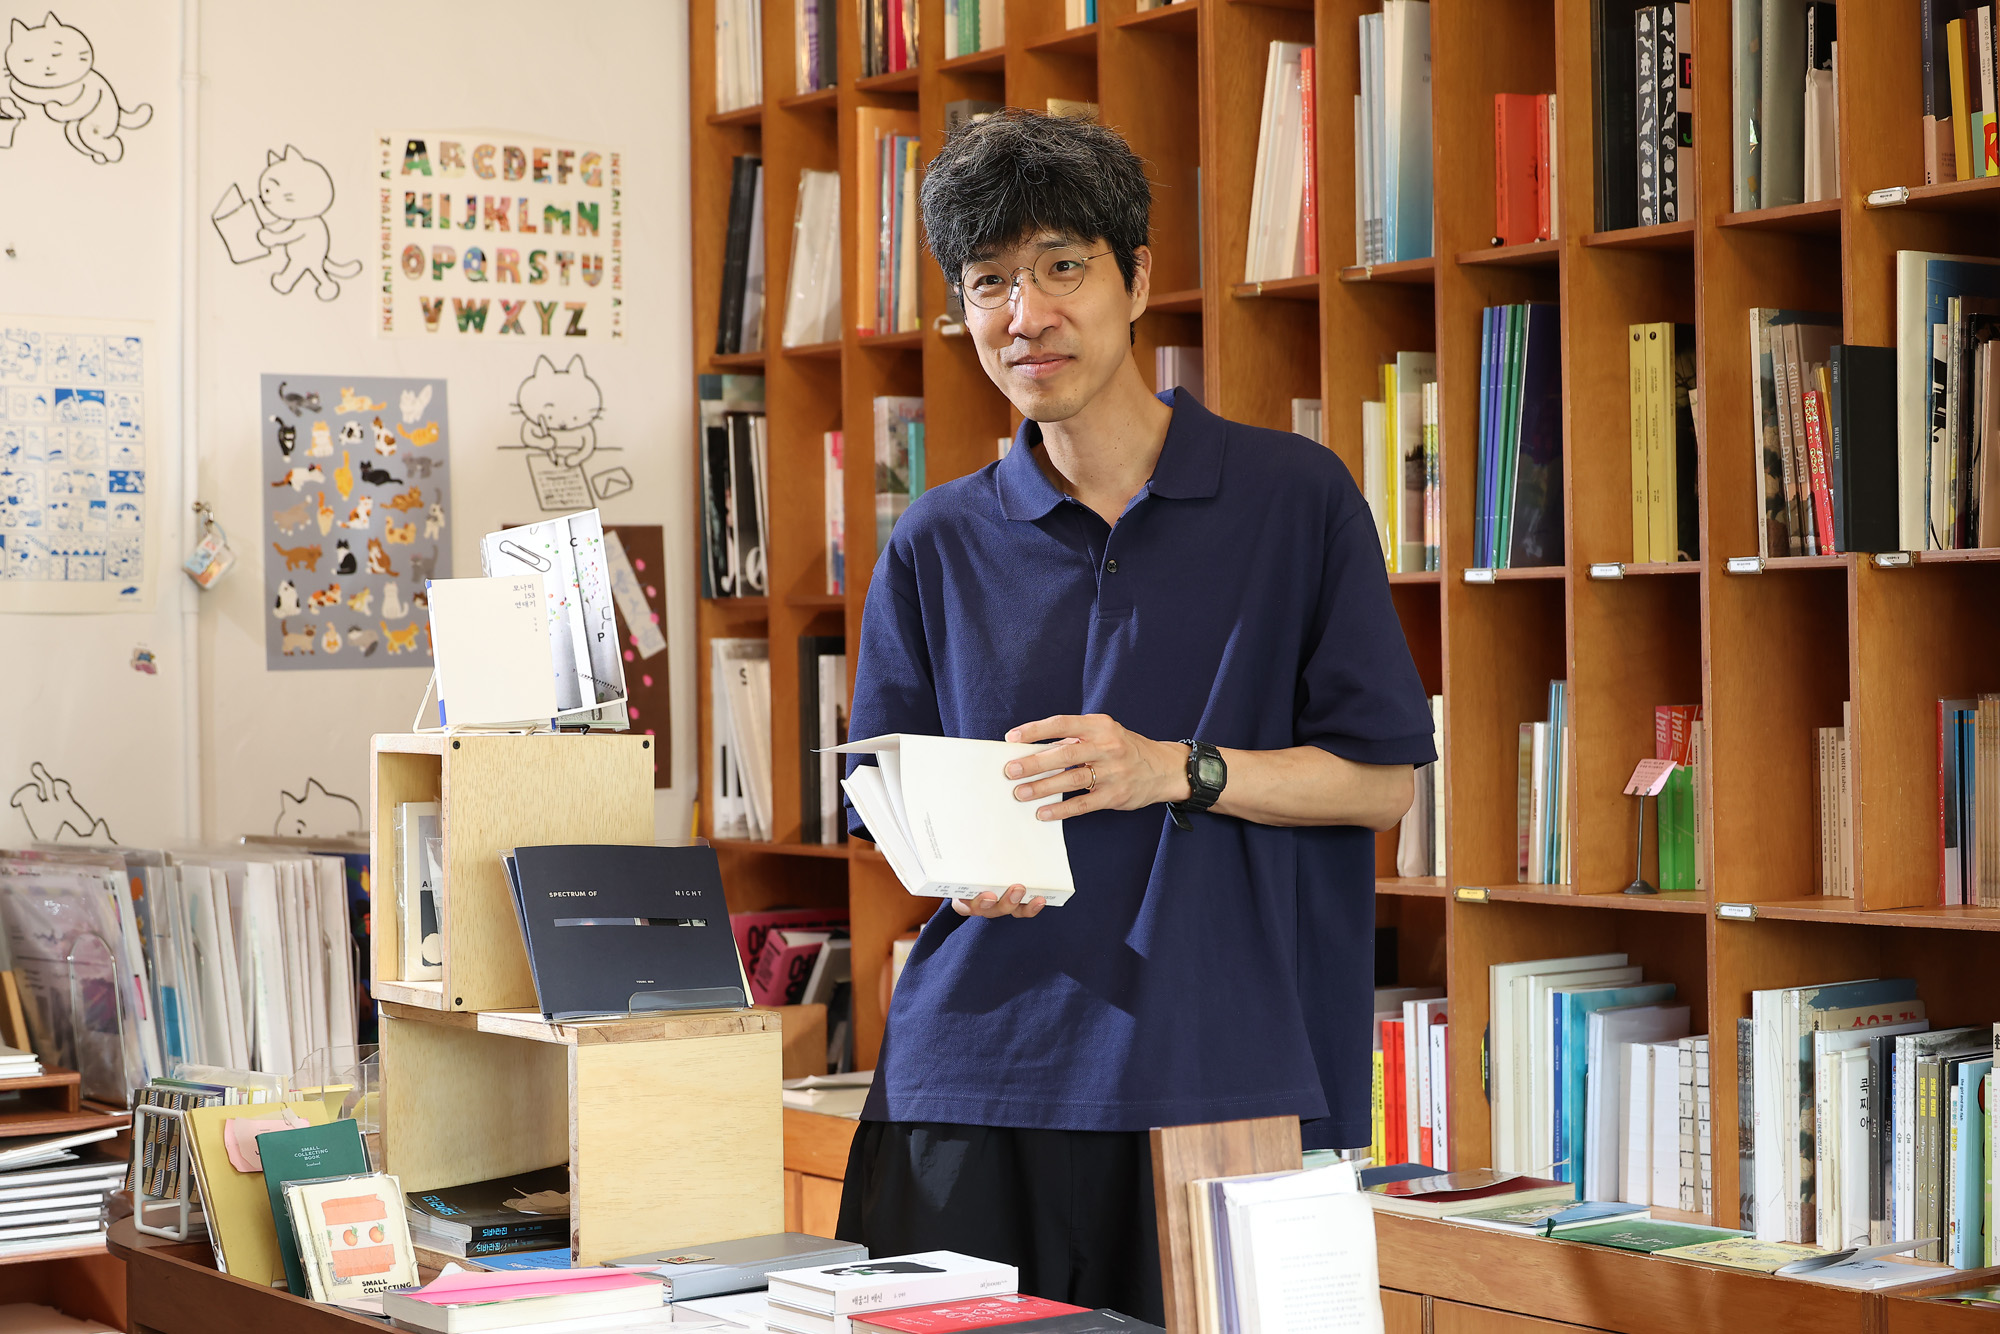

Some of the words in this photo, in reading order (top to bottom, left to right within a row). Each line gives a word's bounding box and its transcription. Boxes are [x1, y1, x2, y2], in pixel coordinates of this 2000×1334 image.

[1775, 363, 1786, 406] Killing
[1788, 362, 1800, 404] Killing
[1779, 414, 1791, 438] and
[1793, 412, 1806, 437] and
[1782, 445, 1792, 484] Dying
[1795, 445, 1807, 483] Dying
[569, 537, 578, 548] C
[512, 583, 534, 591] 모나미
[515, 600, 536, 609] 연대기
[597, 632, 605, 642] P
[549, 890, 586, 898] SPECTRUM
[294, 1148, 329, 1158] COLLECTING
[362, 1279, 388, 1287] SMALL
